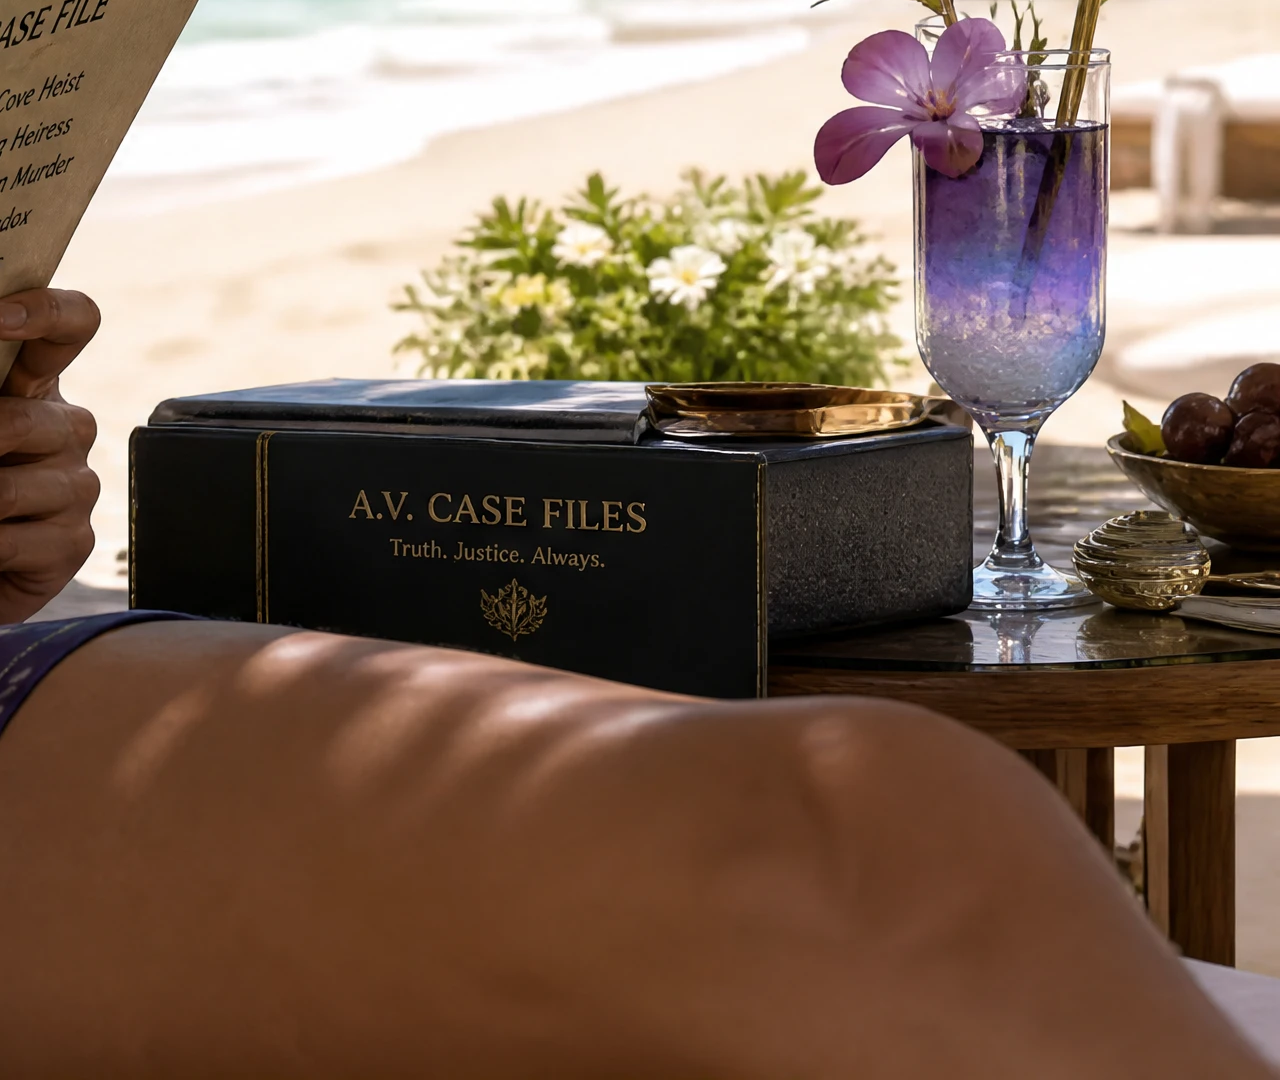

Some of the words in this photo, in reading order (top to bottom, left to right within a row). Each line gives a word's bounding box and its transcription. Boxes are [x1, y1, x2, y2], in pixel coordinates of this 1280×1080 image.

[38, 70, 85, 102] Heist
[10, 117, 74, 152] Heiress
[10, 154, 75, 190] Murder
[348, 489, 413, 521] A.V.
[428, 492, 527, 527] CASE
[542, 498, 648, 533] FILES
[389, 538, 447, 559] Truth.
[453, 541, 524, 563] Justice.
[531, 547, 605, 571] Always.
